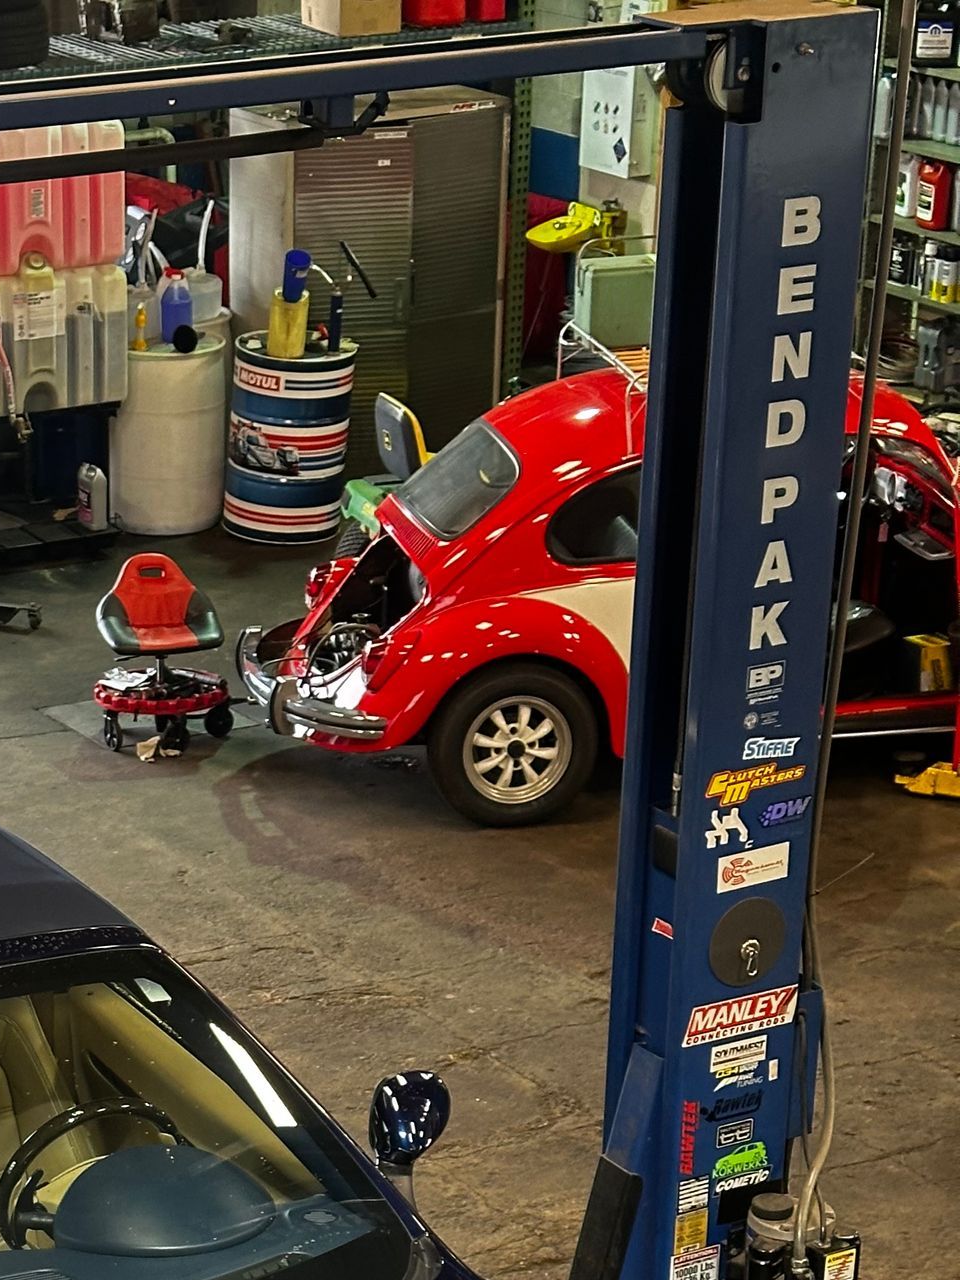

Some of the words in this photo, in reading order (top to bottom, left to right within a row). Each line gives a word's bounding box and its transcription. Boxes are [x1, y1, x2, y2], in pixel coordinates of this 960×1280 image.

[240, 368, 279, 389] MOTUL
[749, 195, 821, 650] BENDPAK
[749, 664, 783, 689] BP
[707, 764, 776, 797] CLUTCH
[721, 767, 805, 805] MASTERS
[769, 797, 812, 819] DW
[690, 990, 788, 1033] MANLEY
[685, 1024, 754, 1046] CONNECTING
[759, 1015, 786, 1029] RODS
[715, 1169, 769, 1193] COMETIC
[675, 1265, 699, 1278] 10000
